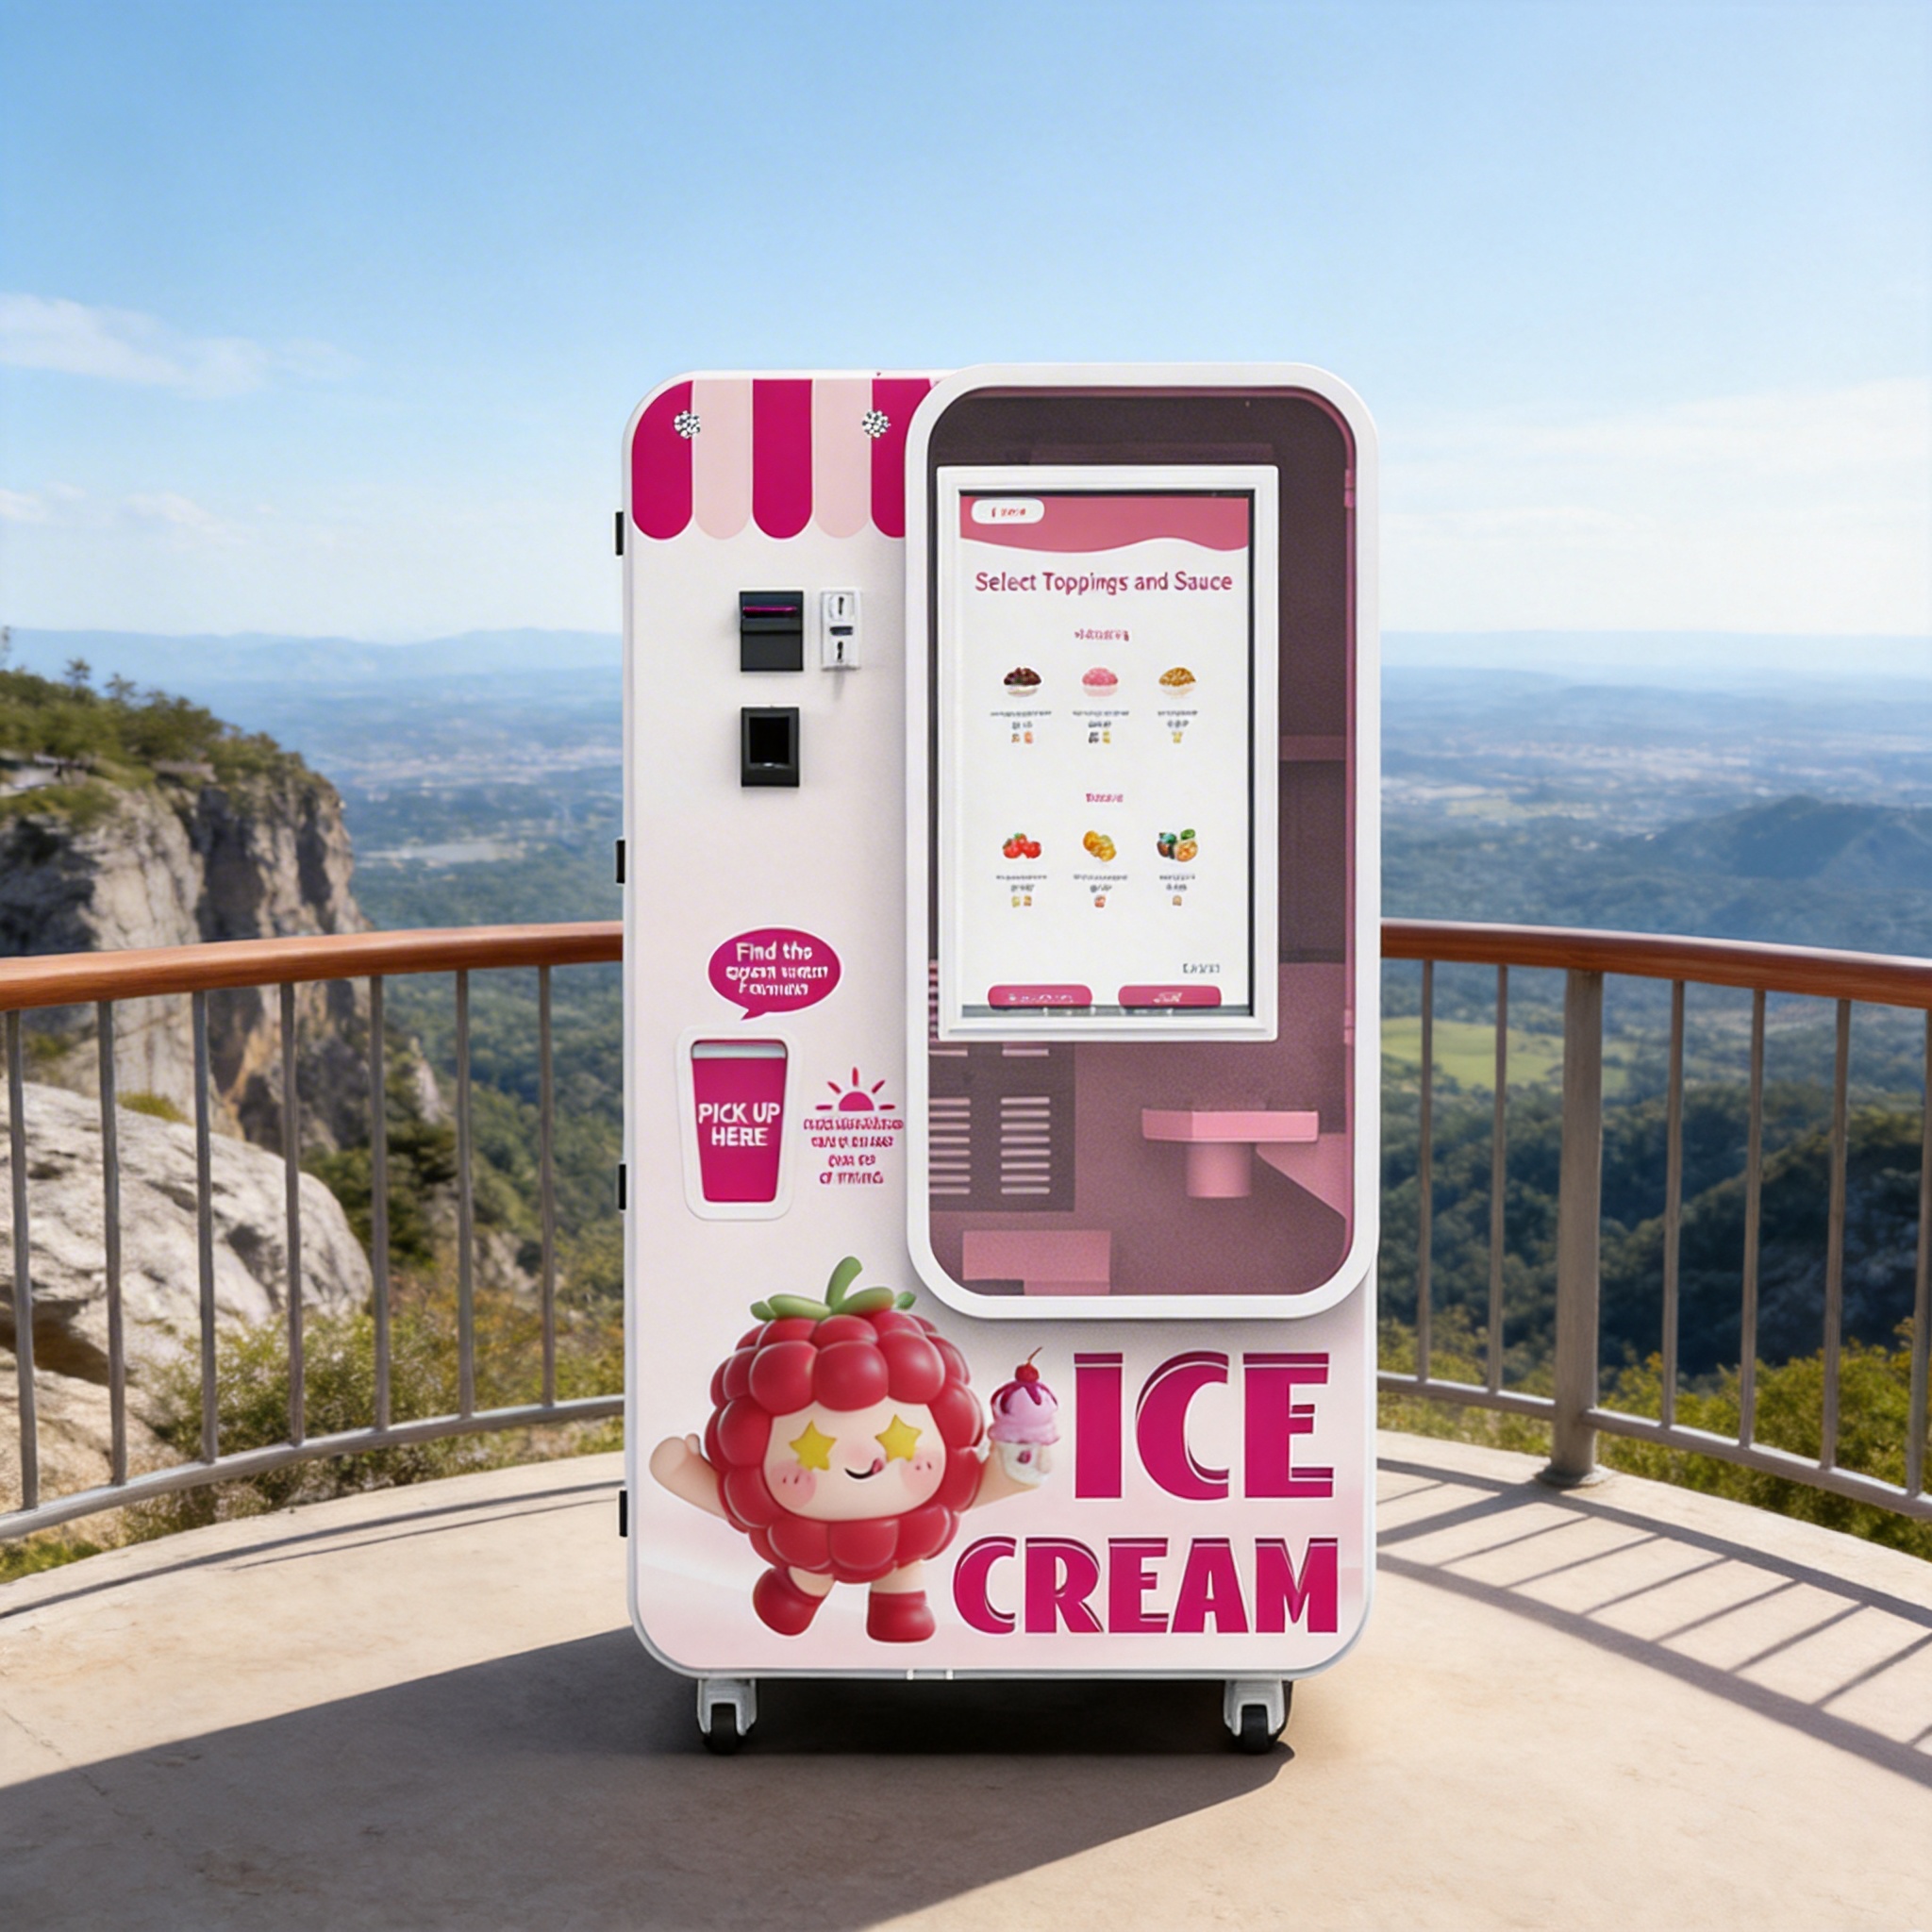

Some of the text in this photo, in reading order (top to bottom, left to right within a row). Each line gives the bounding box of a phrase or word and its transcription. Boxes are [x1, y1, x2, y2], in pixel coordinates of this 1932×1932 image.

[975, 571, 1233, 595] Select Toppings and Sauce
[736, 941, 776, 961] Find
[698, 1102, 781, 1124] PICK UP
[710, 1127, 769, 1147] HERE
[1073, 1349, 1335, 1502] ICE
[952, 1535, 1340, 1636] CREAM
